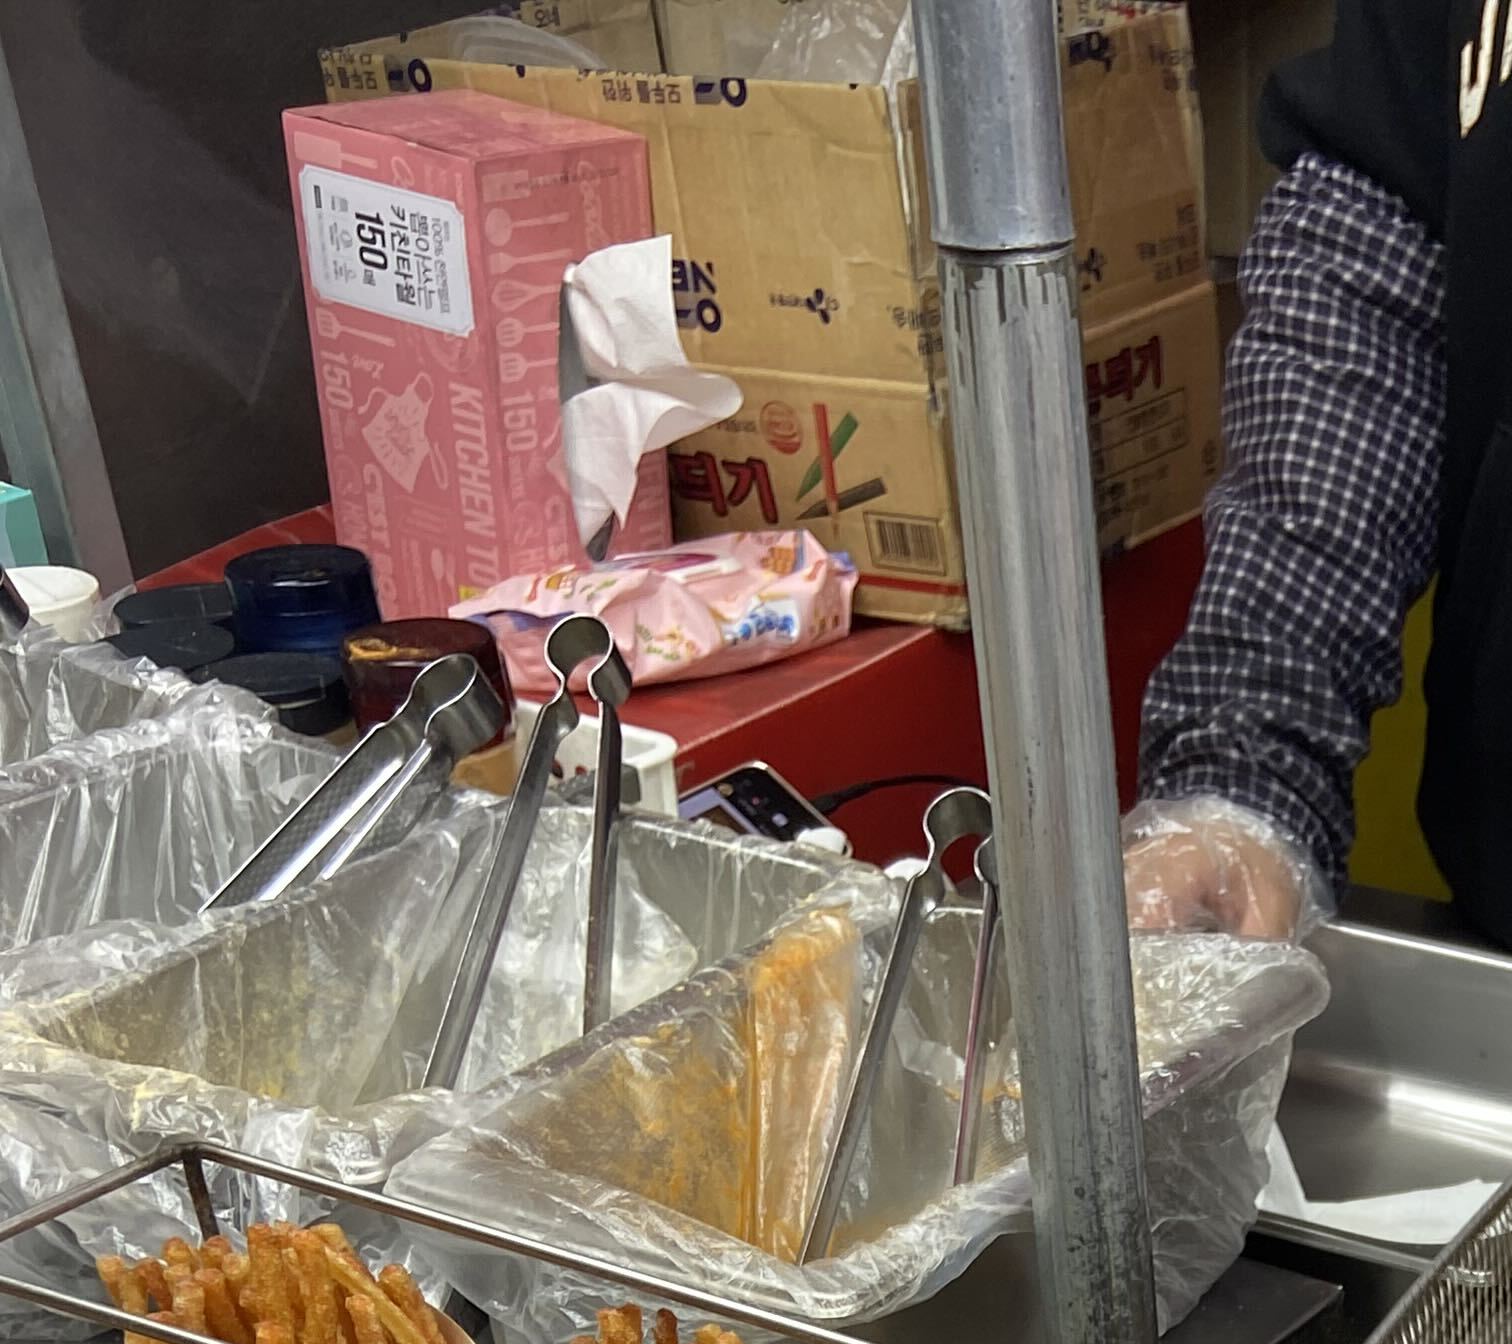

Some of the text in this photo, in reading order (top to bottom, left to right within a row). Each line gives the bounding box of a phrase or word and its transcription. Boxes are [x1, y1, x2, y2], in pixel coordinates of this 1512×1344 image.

[389, 203, 417, 307] 키친타월
[321, 350, 354, 411] 150
[502, 388, 539, 453] 150
[448, 381, 497, 540] KITCHEN
